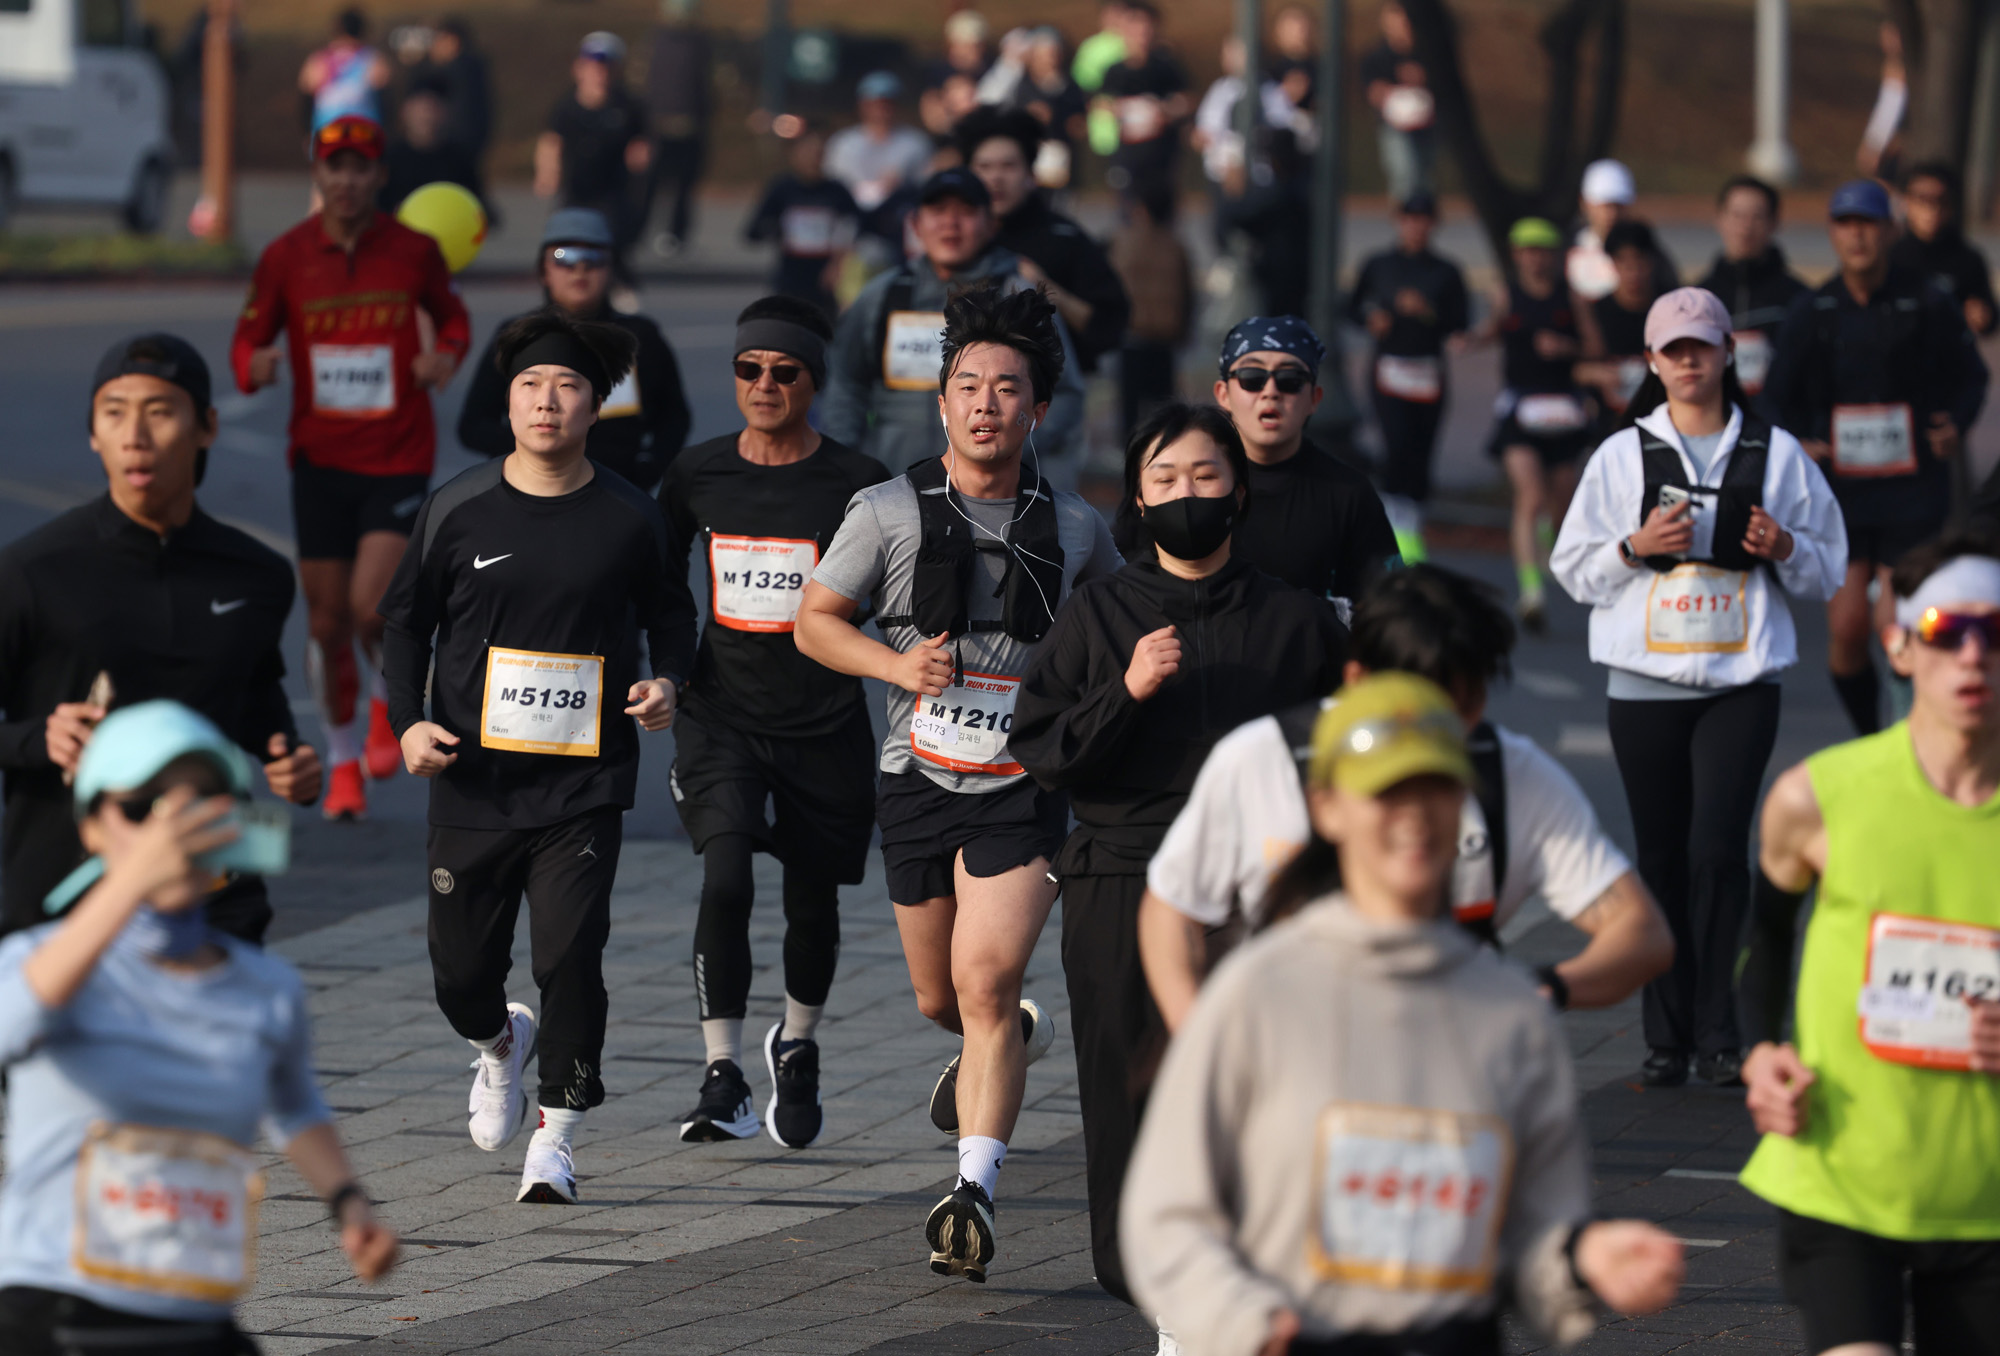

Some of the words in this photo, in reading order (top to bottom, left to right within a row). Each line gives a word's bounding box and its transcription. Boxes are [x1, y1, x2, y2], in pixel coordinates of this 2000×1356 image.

[751, 545, 768, 553] RUN
[770, 546, 796, 555] STORY
[723, 570, 803, 590] M1329
[497, 656, 534, 668] BURNING
[536, 660, 555, 669] RUN
[555, 661, 583, 671] STORY
[965, 679, 986, 690] RUN
[986, 681, 1015, 693] STORY
[500, 686, 587, 710] M5138
[929, 702, 1014, 733] M1210
[491, 725, 509, 734] 5km
[914, 718, 946, 736] C-173
[918, 739, 939, 750] 10km
